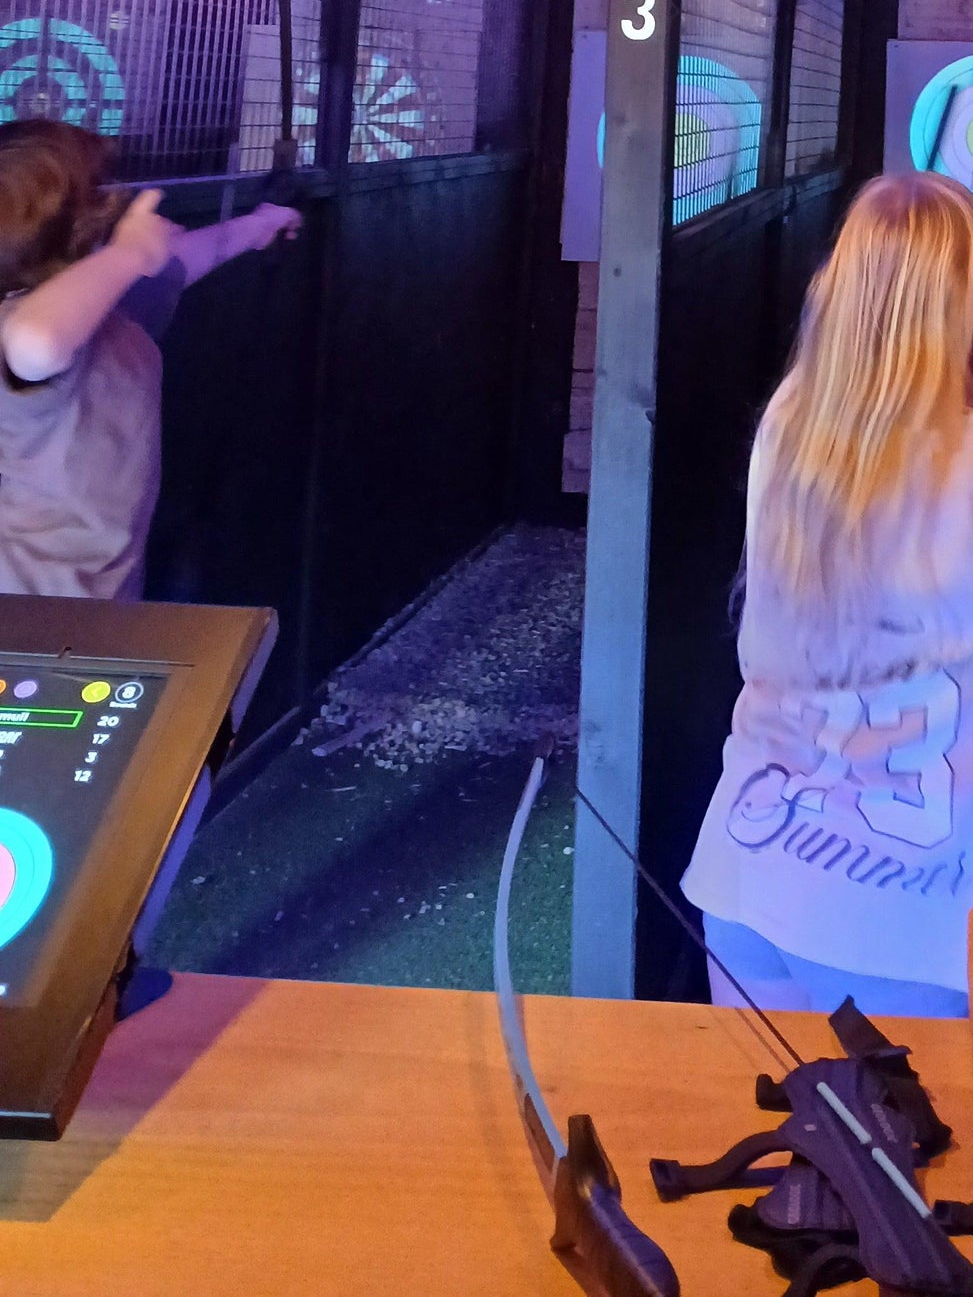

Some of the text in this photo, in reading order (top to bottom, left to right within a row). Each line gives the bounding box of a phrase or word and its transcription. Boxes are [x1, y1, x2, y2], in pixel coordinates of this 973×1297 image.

[121, 686, 137, 700] 8
[97, 715, 120, 728] 20
[92, 733, 111, 745] 17
[84, 751, 98, 764] 3
[73, 769, 92, 783] 12
